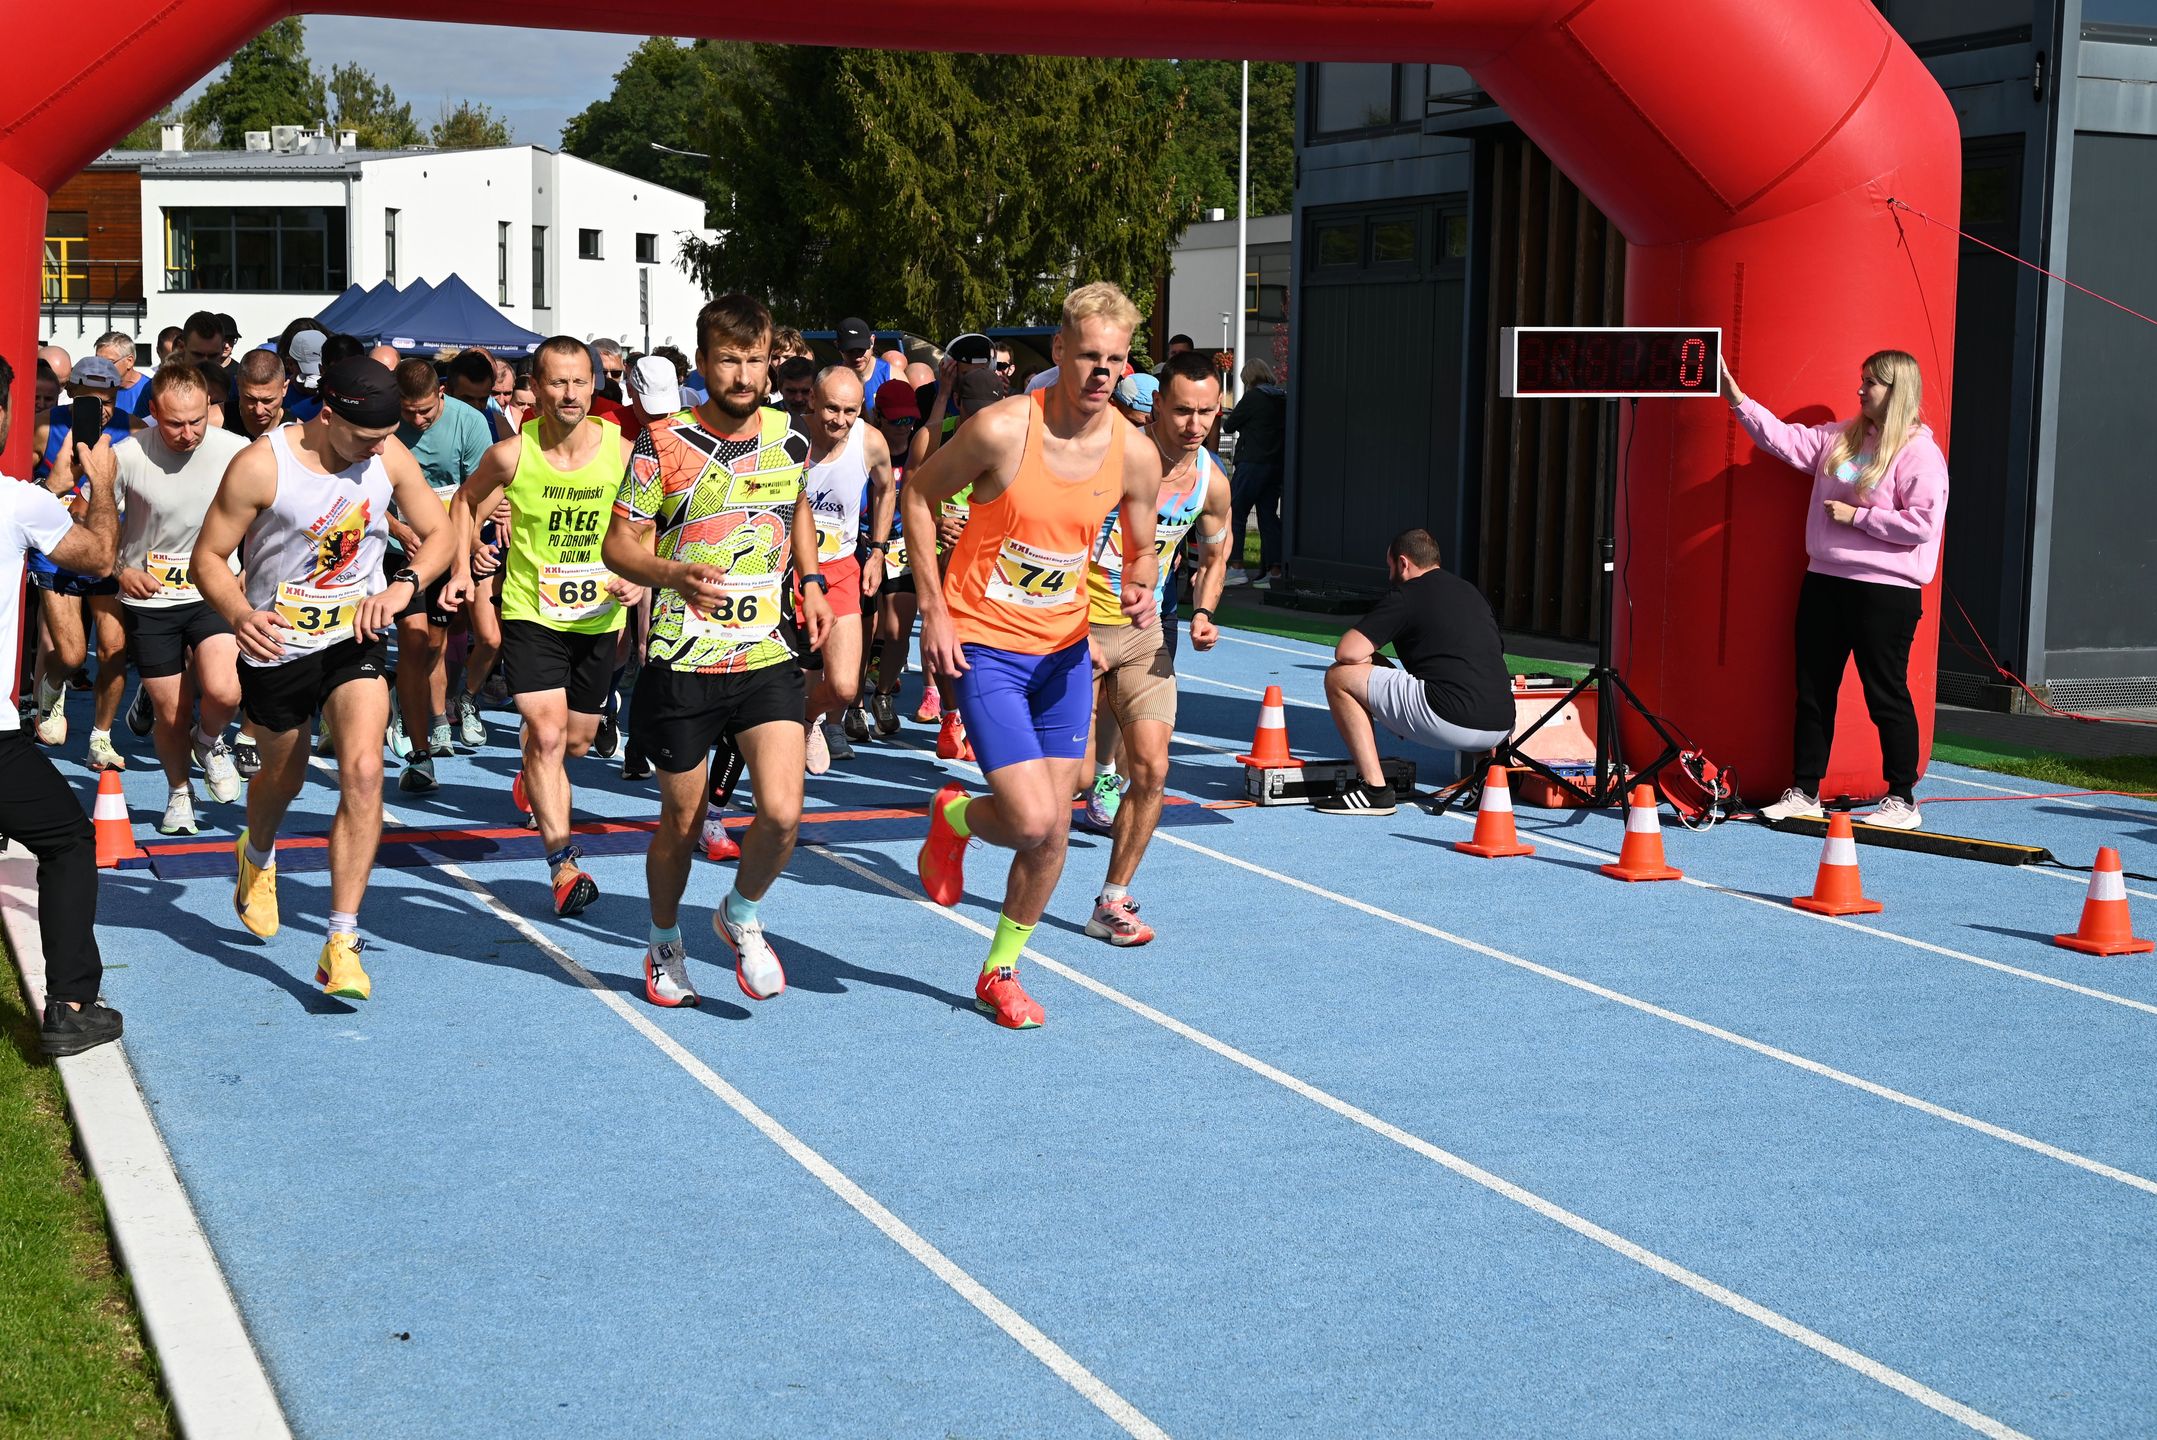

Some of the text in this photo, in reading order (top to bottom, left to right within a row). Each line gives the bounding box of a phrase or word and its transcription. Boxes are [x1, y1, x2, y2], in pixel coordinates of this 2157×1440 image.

[1679, 338, 1706, 387] 0
[541, 485, 605, 501] XVIII Rypiński
[548, 533, 600, 547] PO ZDROWIE
[559, 550, 591, 563] DOLINA
[1018, 562, 1065, 592] 74
[285, 586, 305, 597] XXI
[559, 579, 597, 604] 68
[296, 605, 341, 630] 31
[711, 595, 758, 622] 86
